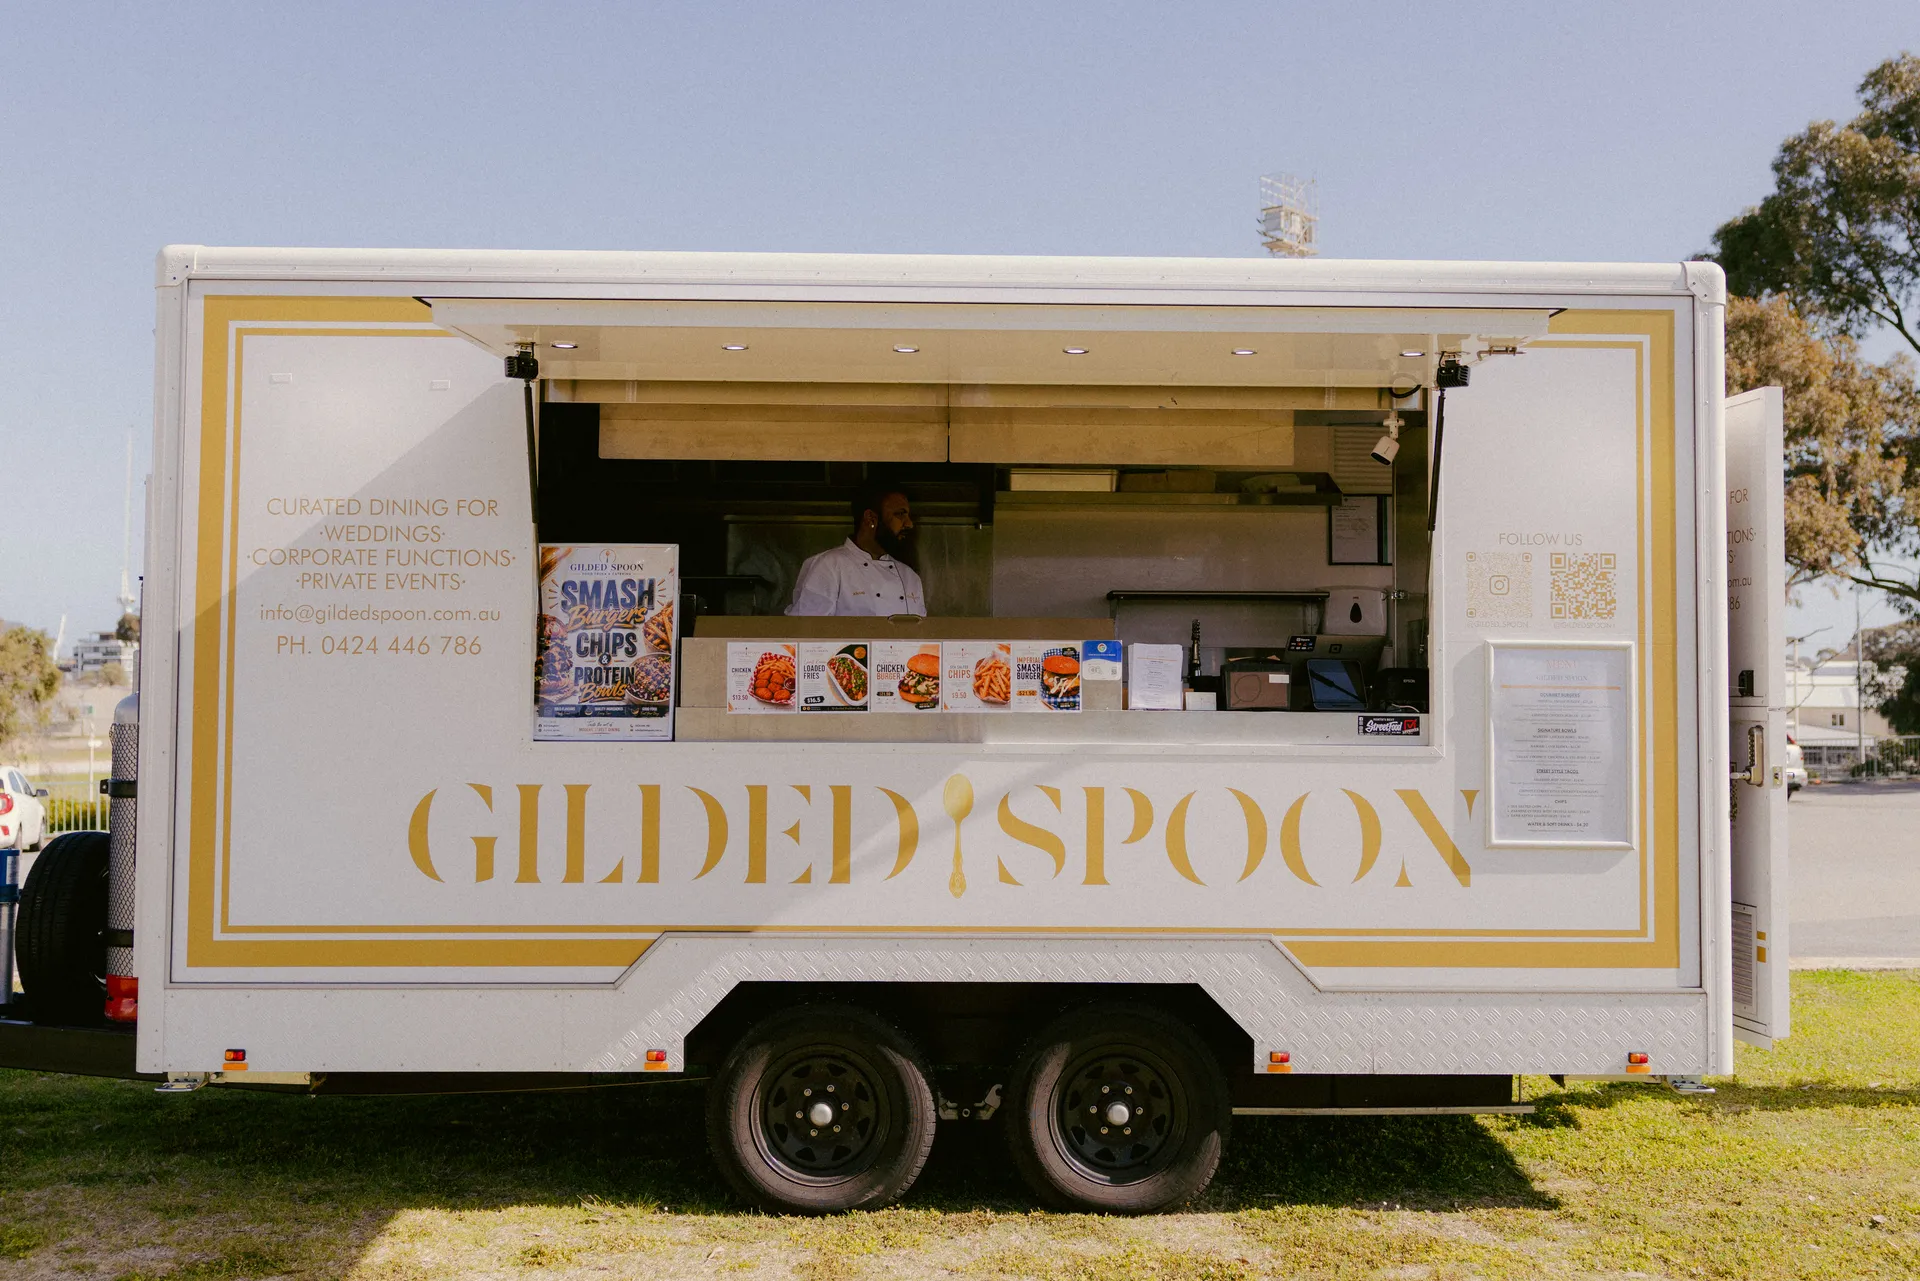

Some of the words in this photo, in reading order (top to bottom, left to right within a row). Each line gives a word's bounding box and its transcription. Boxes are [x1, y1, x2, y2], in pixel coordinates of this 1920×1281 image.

[1729, 488, 1748, 504] FOR
[267, 498, 361, 516] CURATED
[370, 498, 448, 517] DINING
[457, 499, 499, 517] FOR
[1499, 533, 1559, 546] FOLLOW
[1565, 533, 1583, 546] US
[570, 563, 607, 571] GILDED
[611, 563, 644, 571] SPOON
[561, 578, 656, 613] SMASH
[1728, 596, 1741, 611] 86
[260, 604, 501, 625] info@gildedspoon.com.au
[567, 604, 648, 632] Burgers
[277, 635, 312, 655] PH.
[321, 635, 378, 655] 0424
[388, 635, 431, 655] 446
[440, 635, 482, 655] 786
[576, 632, 638, 658] CHIPS
[601, 655, 609, 664] &
[803, 665, 826, 673] LOADED
[876, 664, 905, 673] CHICKEN
[948, 670, 971, 679] CHIPS
[1016, 663, 1041, 672] SMASH
[574, 666, 636, 686] PROTEIN
[803, 672, 820, 680] FRIES
[1016, 672, 1041, 680] BURGER
[578, 681, 627, 703] Bowls
[408, 782, 919, 885] GILDED
[997, 784, 1480, 888] SPOON
